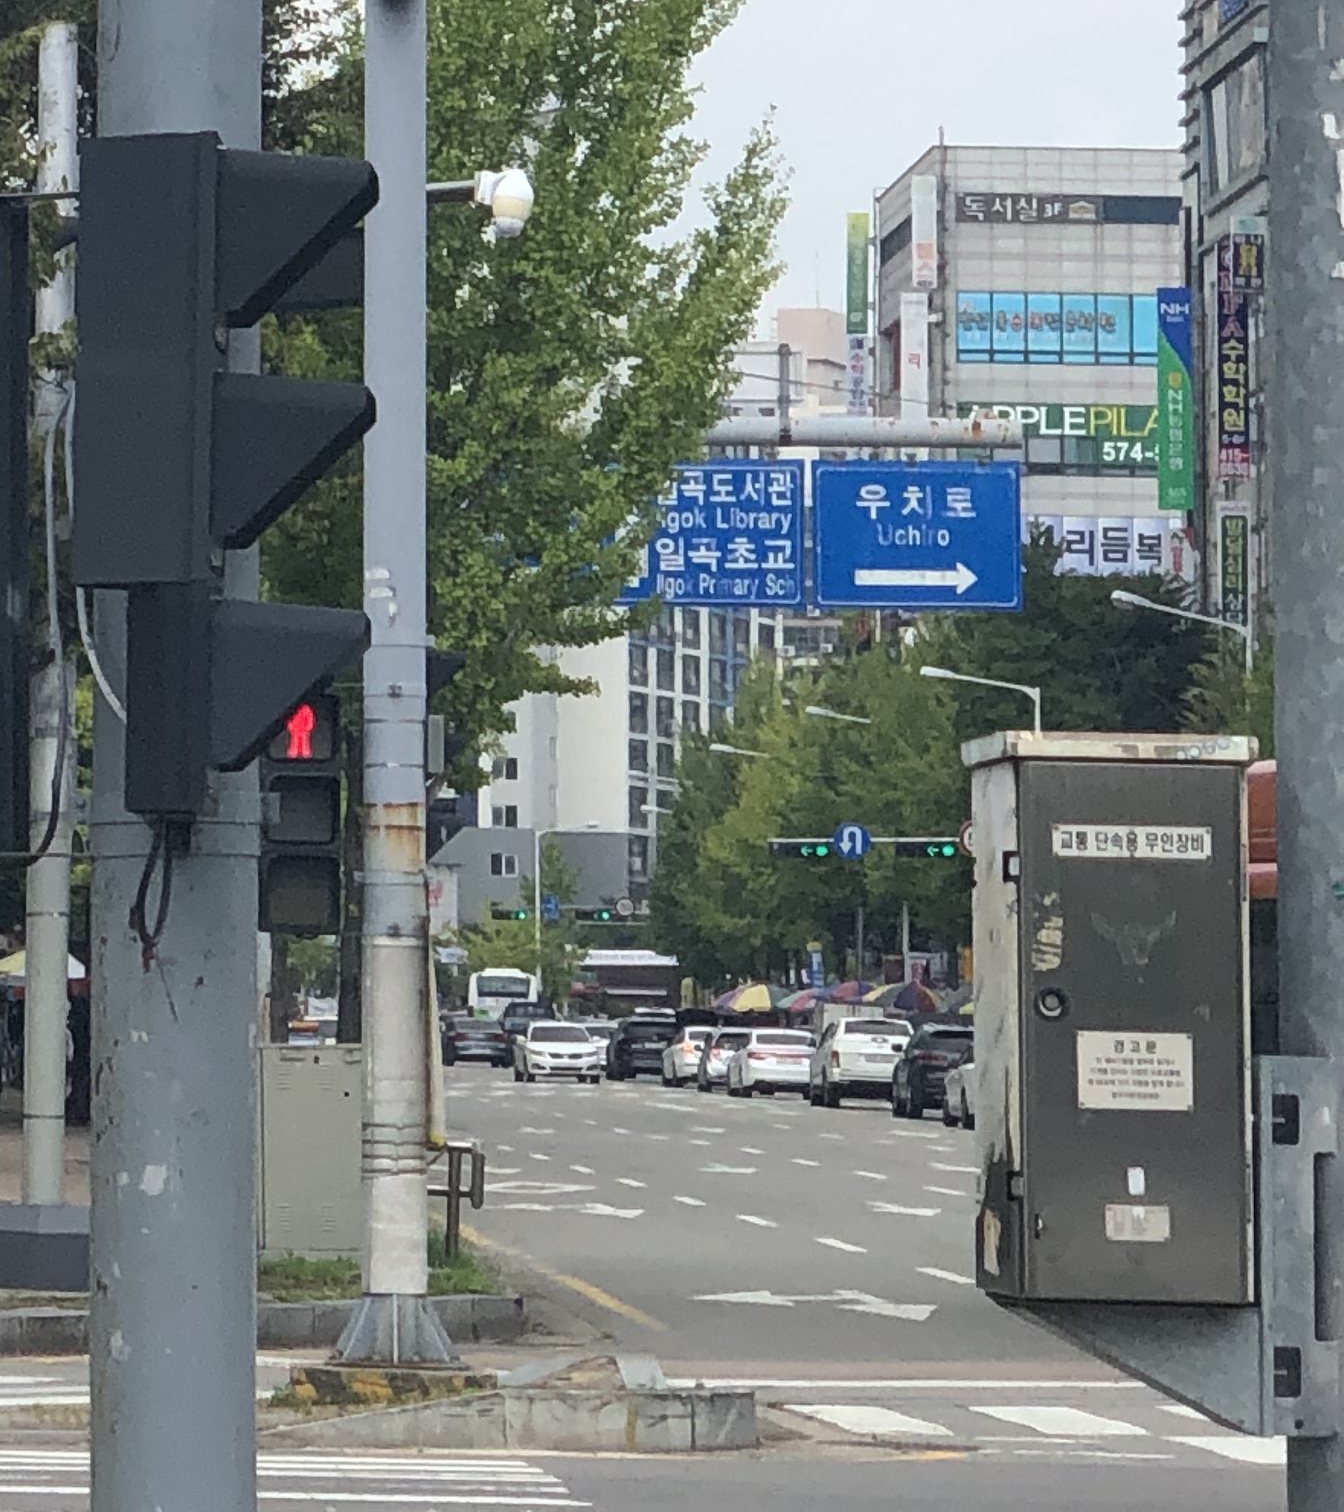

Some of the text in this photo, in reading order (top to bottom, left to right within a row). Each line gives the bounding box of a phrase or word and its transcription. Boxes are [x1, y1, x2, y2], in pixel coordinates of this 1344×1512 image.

[963, 195, 1039, 222] 독서실
[1160, 302, 1190, 316] NH
[855, 482, 978, 520] 우치로
[716, 506, 792, 535] Library
[876, 522, 950, 548] Uchiro
[655, 536, 796, 573] 일곡초교
[1060, 830, 1088, 851] 교통
[1144, 831, 1204, 853] 무인장비
